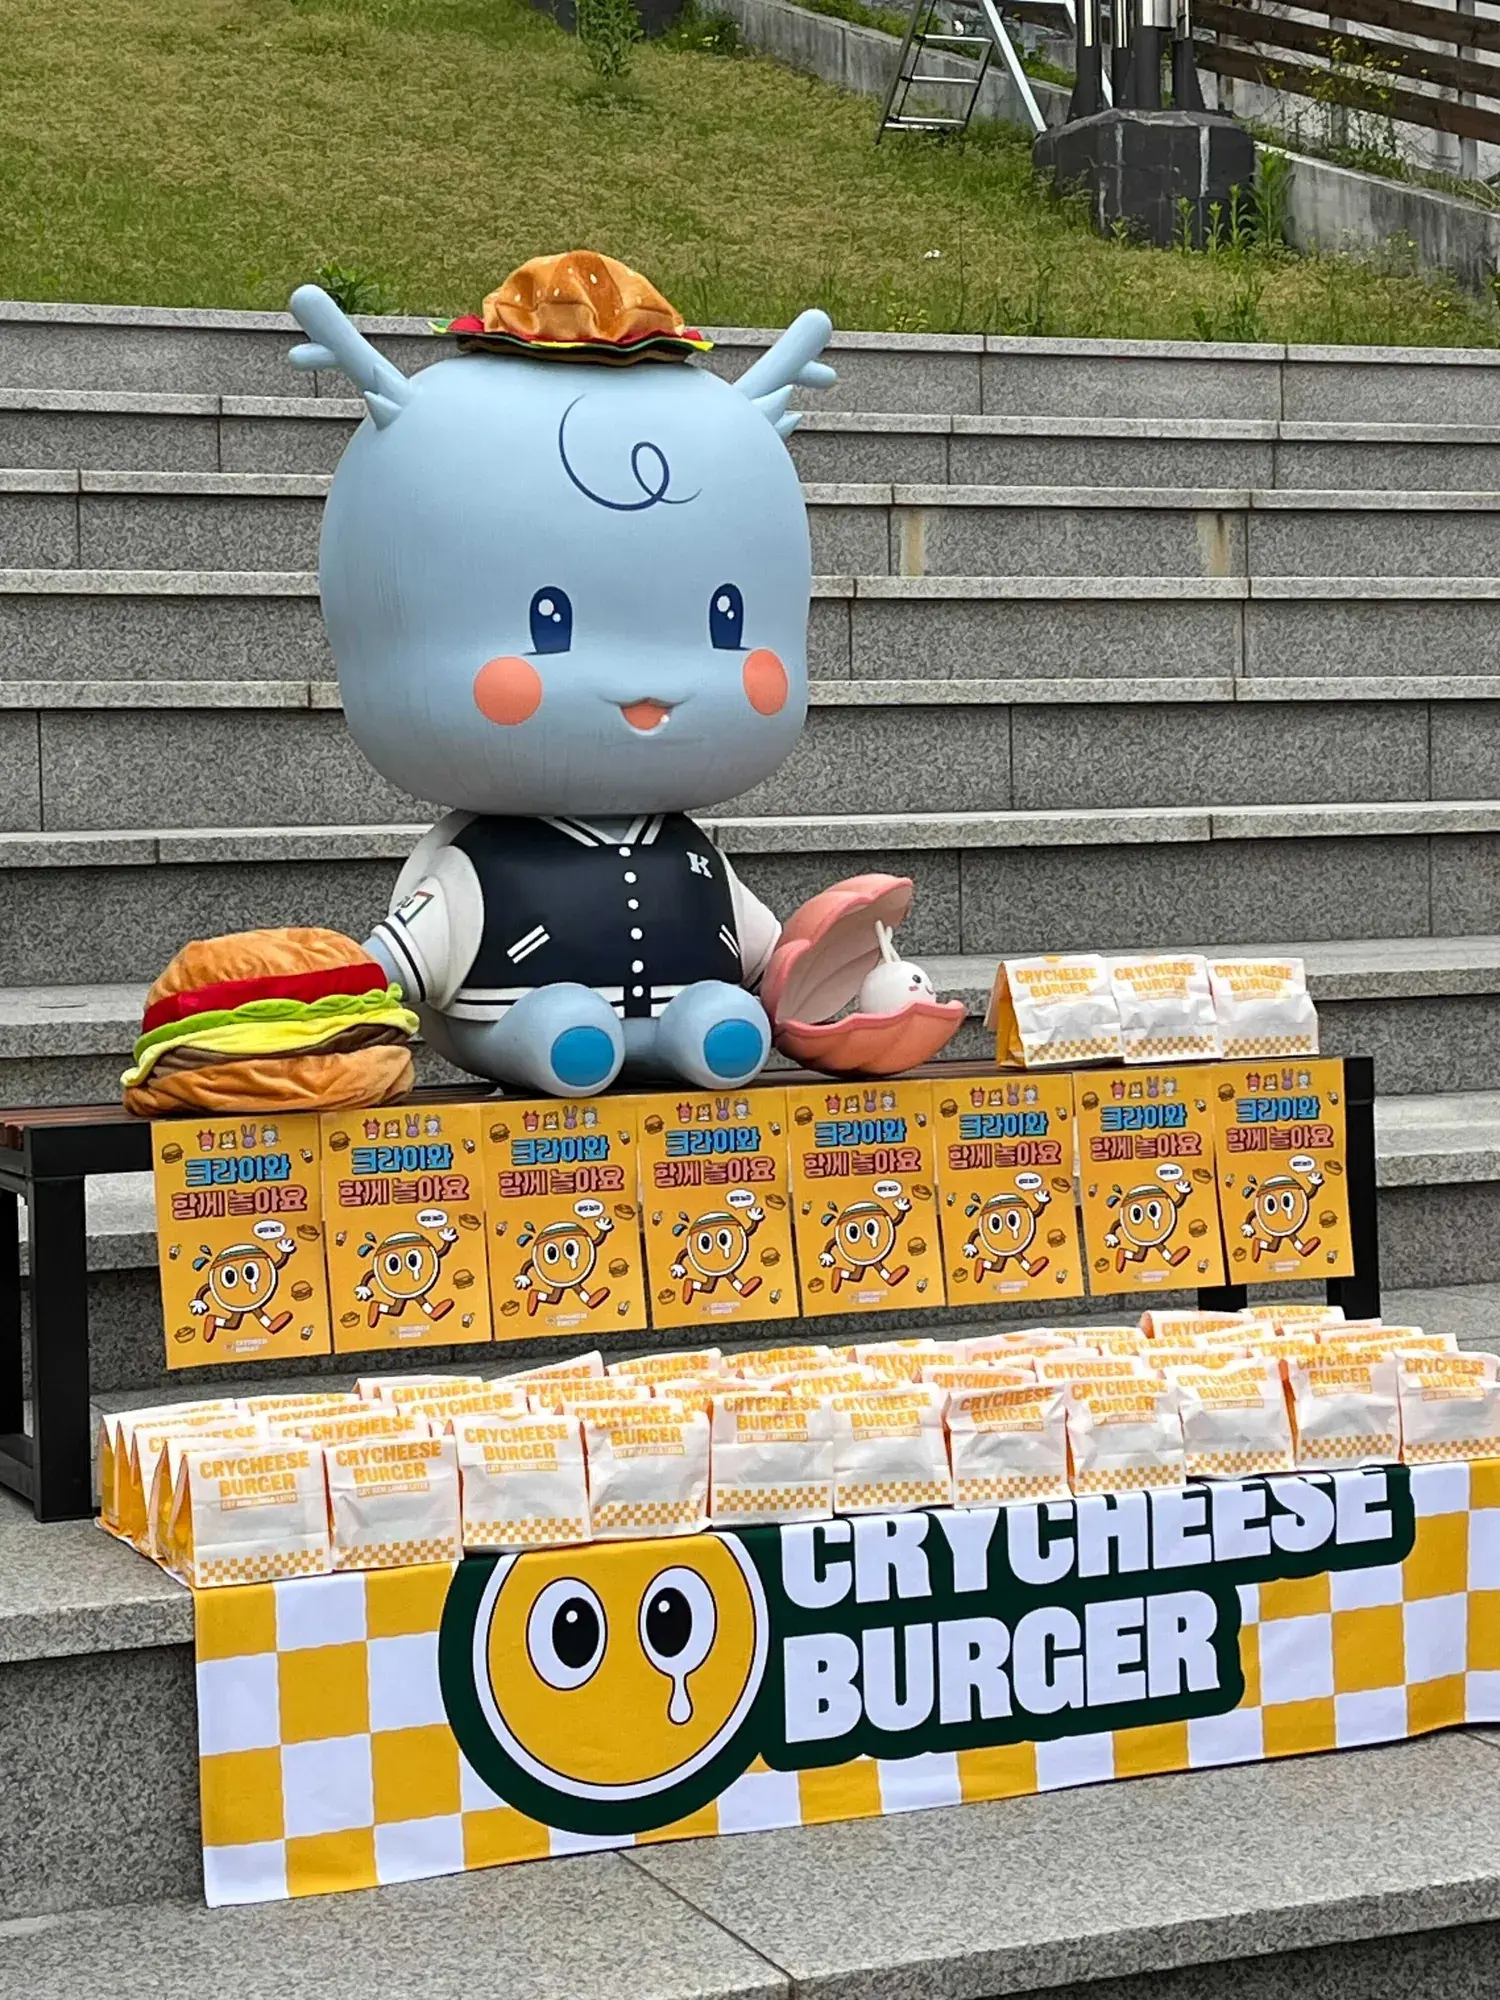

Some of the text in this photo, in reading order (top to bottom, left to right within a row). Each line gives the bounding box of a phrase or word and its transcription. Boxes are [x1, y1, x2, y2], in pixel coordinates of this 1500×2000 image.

[686, 851, 713, 879] K
[1015, 967, 1097, 984] CRYCHEESE
[1114, 962, 1197, 981] CRYCHEESE
[1214, 965, 1292, 980] CRYCHEESE
[1030, 983, 1090, 997] BURGER
[1100, 1103, 1188, 1132] 크라이와
[1236, 1096, 1321, 1124] 크라이와
[815, 1117, 907, 1147] 크라이와
[959, 1112, 1049, 1141] 크라이와
[1225, 1123, 1334, 1153] 함께 놀아요
[511, 1134, 610, 1165] 크라이와
[665, 1127, 761, 1157] 크라이와
[1090, 1131, 1202, 1162] 함께 놀아요
[351, 1144, 453, 1174] 크라이와
[803, 1147, 922, 1179] 함께 놀아요
[948, 1140, 1062, 1170] 함께 놀아요
[185, 1154, 290, 1186] 크라이와
[499, 1165, 625, 1197] 함께 놀아요
[654, 1156, 775, 1188] 함께 놀아요
[172, 1185, 307, 1219] 함께 놀아요
[339, 1174, 469, 1206] 함께 놀아요
[619, 1356, 710, 1375] CRYCHEESE
[1044, 1361, 1133, 1378] CRYCHEESE
[1177, 1367, 1268, 1387] CRYCHEESE
[1309, 1367, 1372, 1386] BURGER
[932, 1371, 1024, 1389] CRYCHEESE
[1071, 1379, 1168, 1400] CRYCHEESE
[724, 1396, 821, 1412] CRYCHEESE
[832, 1392, 931, 1411] CRYCHEESE
[960, 1387, 1059, 1411] CRYCHEESE
[1088, 1396, 1155, 1414] BURGER
[737, 1413, 807, 1431] BURGER
[851, 1410, 920, 1428] BURGER
[971, 1405, 1042, 1424] BURGER
[311, 1416, 416, 1440] CRYCHEESE
[464, 1424, 567, 1443] CRYCHEESE
[610, 1426, 682, 1447] BURGER
[336, 1440, 442, 1467] CRYCHEESE
[483, 1443, 556, 1461] BURGER
[200, 1450, 311, 1479] CRYCHEESE
[353, 1462, 427, 1485] BURGER
[219, 1473, 296, 1498] BURGER
[781, 1471, 1394, 1609] CRYCHEESE
[783, 1589, 1220, 1744] BURGER
